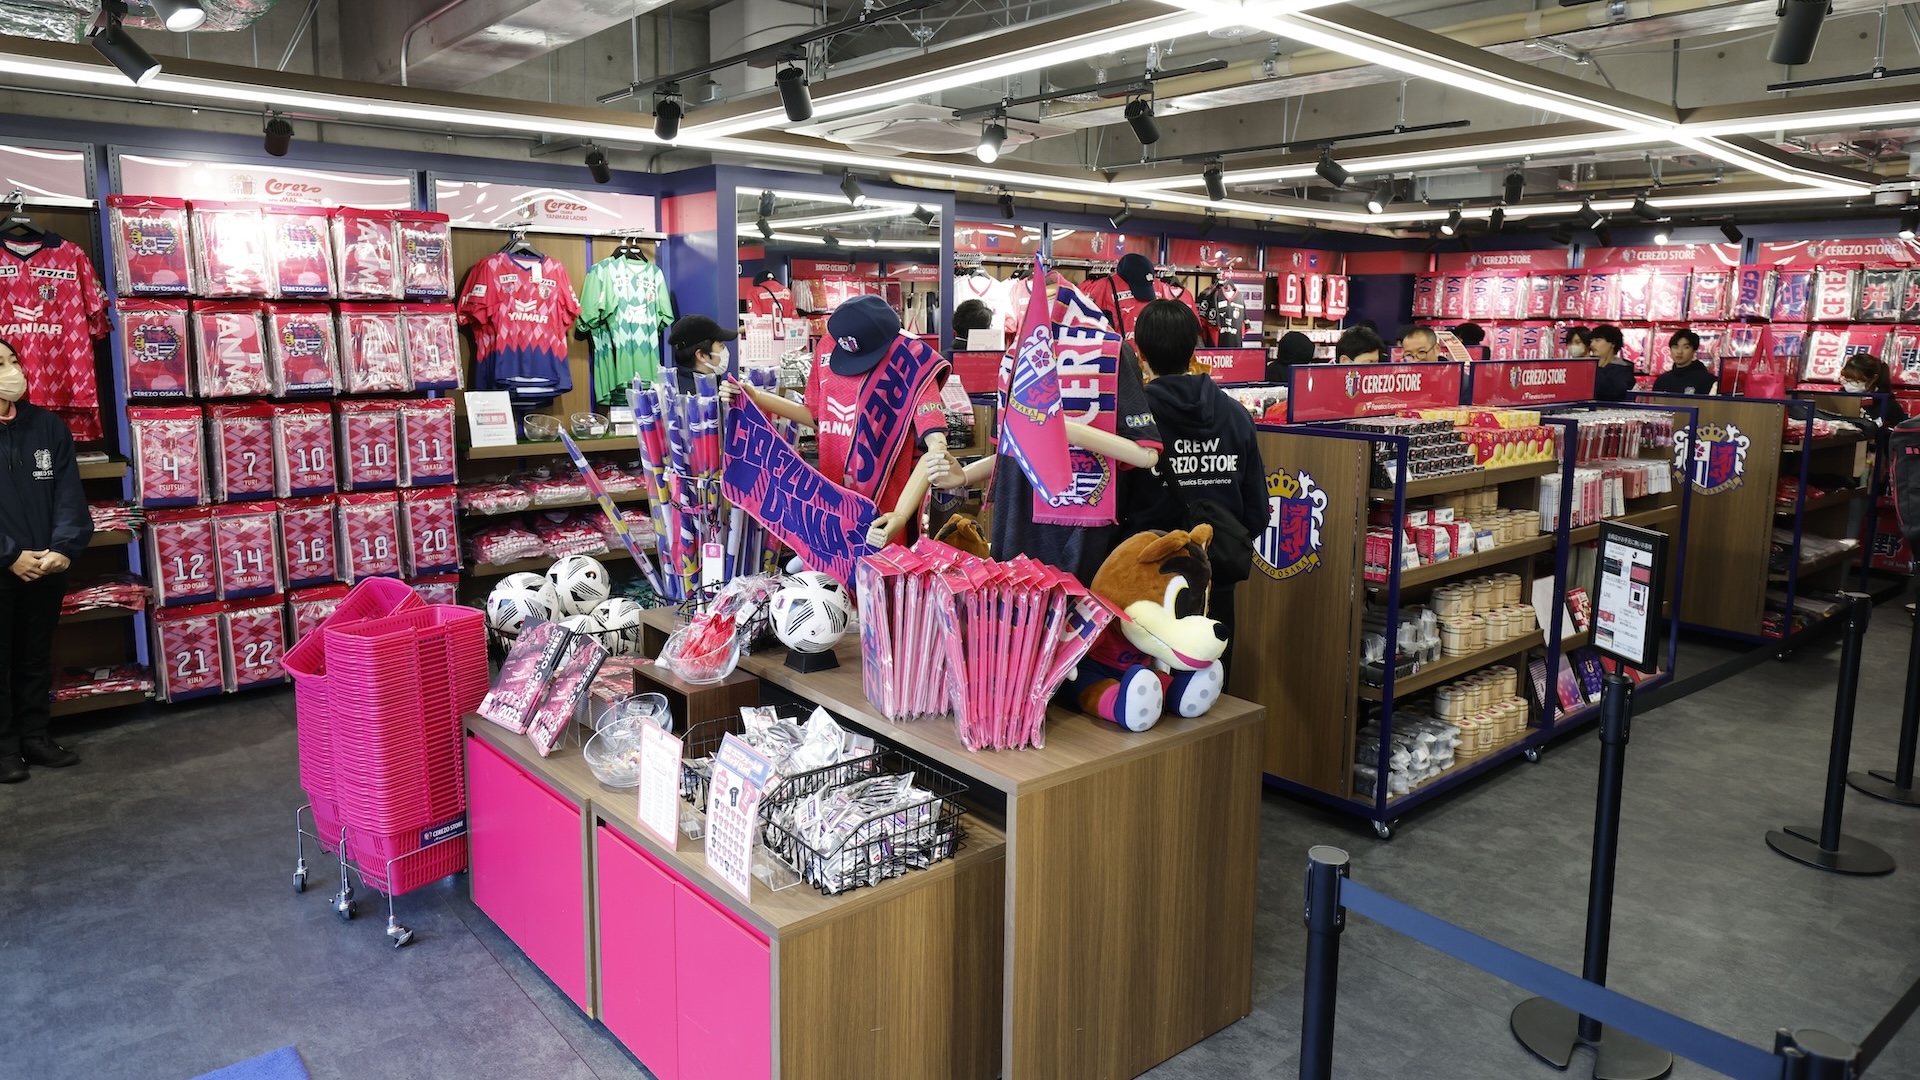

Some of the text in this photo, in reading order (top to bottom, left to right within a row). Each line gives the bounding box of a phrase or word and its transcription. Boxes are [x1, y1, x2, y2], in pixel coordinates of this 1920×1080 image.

[265, 178, 322, 195] Cerezo
[544, 199, 588, 212] Cerezo
[1482, 254, 1531, 265] CEREZO STORE
[1637, 249, 1696, 261] CEREZO STORE
[1825, 244, 1897, 256] CEREZO STORE
[282, 285, 304, 293] CEREZO
[1286, 273, 1297, 304] 6
[1311, 275, 1320, 304] 8
[1329, 277, 1347, 308] 13
[1421, 297, 1428, 309] 1
[1449, 296, 1456, 310] 2
[1536, 296, 1544, 310] 5
[1566, 295, 1575, 310] 6
[1213, 355, 1234, 368] STORE
[1362, 374, 1422, 394] CEREZO STORE
[1522, 368, 1567, 386] CEREZO STORE
[360, 442, 389, 467] 10
[417, 438, 445, 463] 11
[1174, 437, 1220, 454] CREW
[162, 455, 179, 481] 4
[243, 452, 257, 477] 7
[296, 446, 325, 473] 10
[1151, 454, 1238, 476] CREZO STORE
[1197, 478, 1232, 487] Experience
[296, 537, 325, 564] 16
[360, 535, 389, 562] 18
[421, 528, 448, 553] 20
[173, 553, 206, 582] 12
[232, 548, 264, 575] 14
[1252, 551, 1308, 578] EREZO OSAKA
[176, 648, 210, 677] 21
[244, 639, 274, 669] 22
[519, 630, 564, 709] CEREZO OSAKA
[187, 677, 204, 685] RINA
[499, 704, 523, 721] 2025
